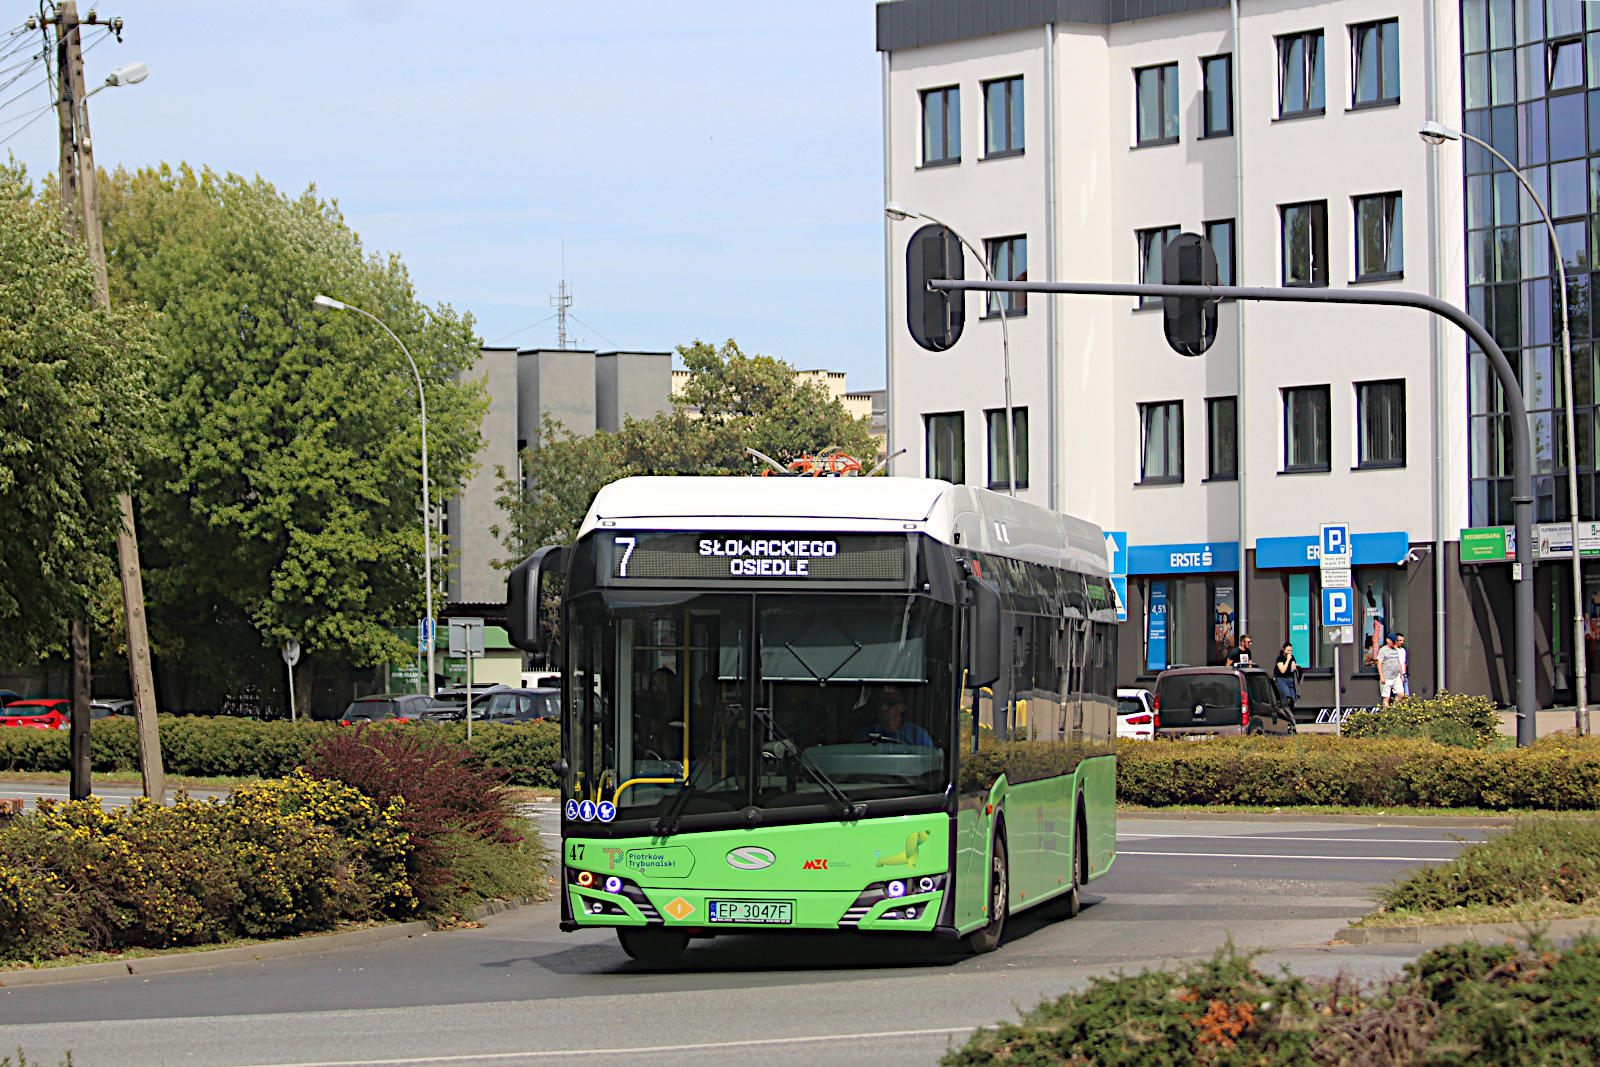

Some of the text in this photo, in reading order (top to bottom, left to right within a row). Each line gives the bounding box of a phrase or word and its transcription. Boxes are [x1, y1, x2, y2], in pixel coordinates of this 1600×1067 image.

[700, 540, 837, 556] SŁOWACKIEGO
[1329, 530, 1342, 551] P
[615, 537, 636, 577] 7
[1170, 553, 1200, 567] ERSTE
[730, 559, 809, 575] OSIEDLE
[1329, 592, 1346, 621] P
[569, 844, 585, 861] 47
[629, 860, 676, 868] Trybunalski
[719, 903, 787, 918] EP 3047F
